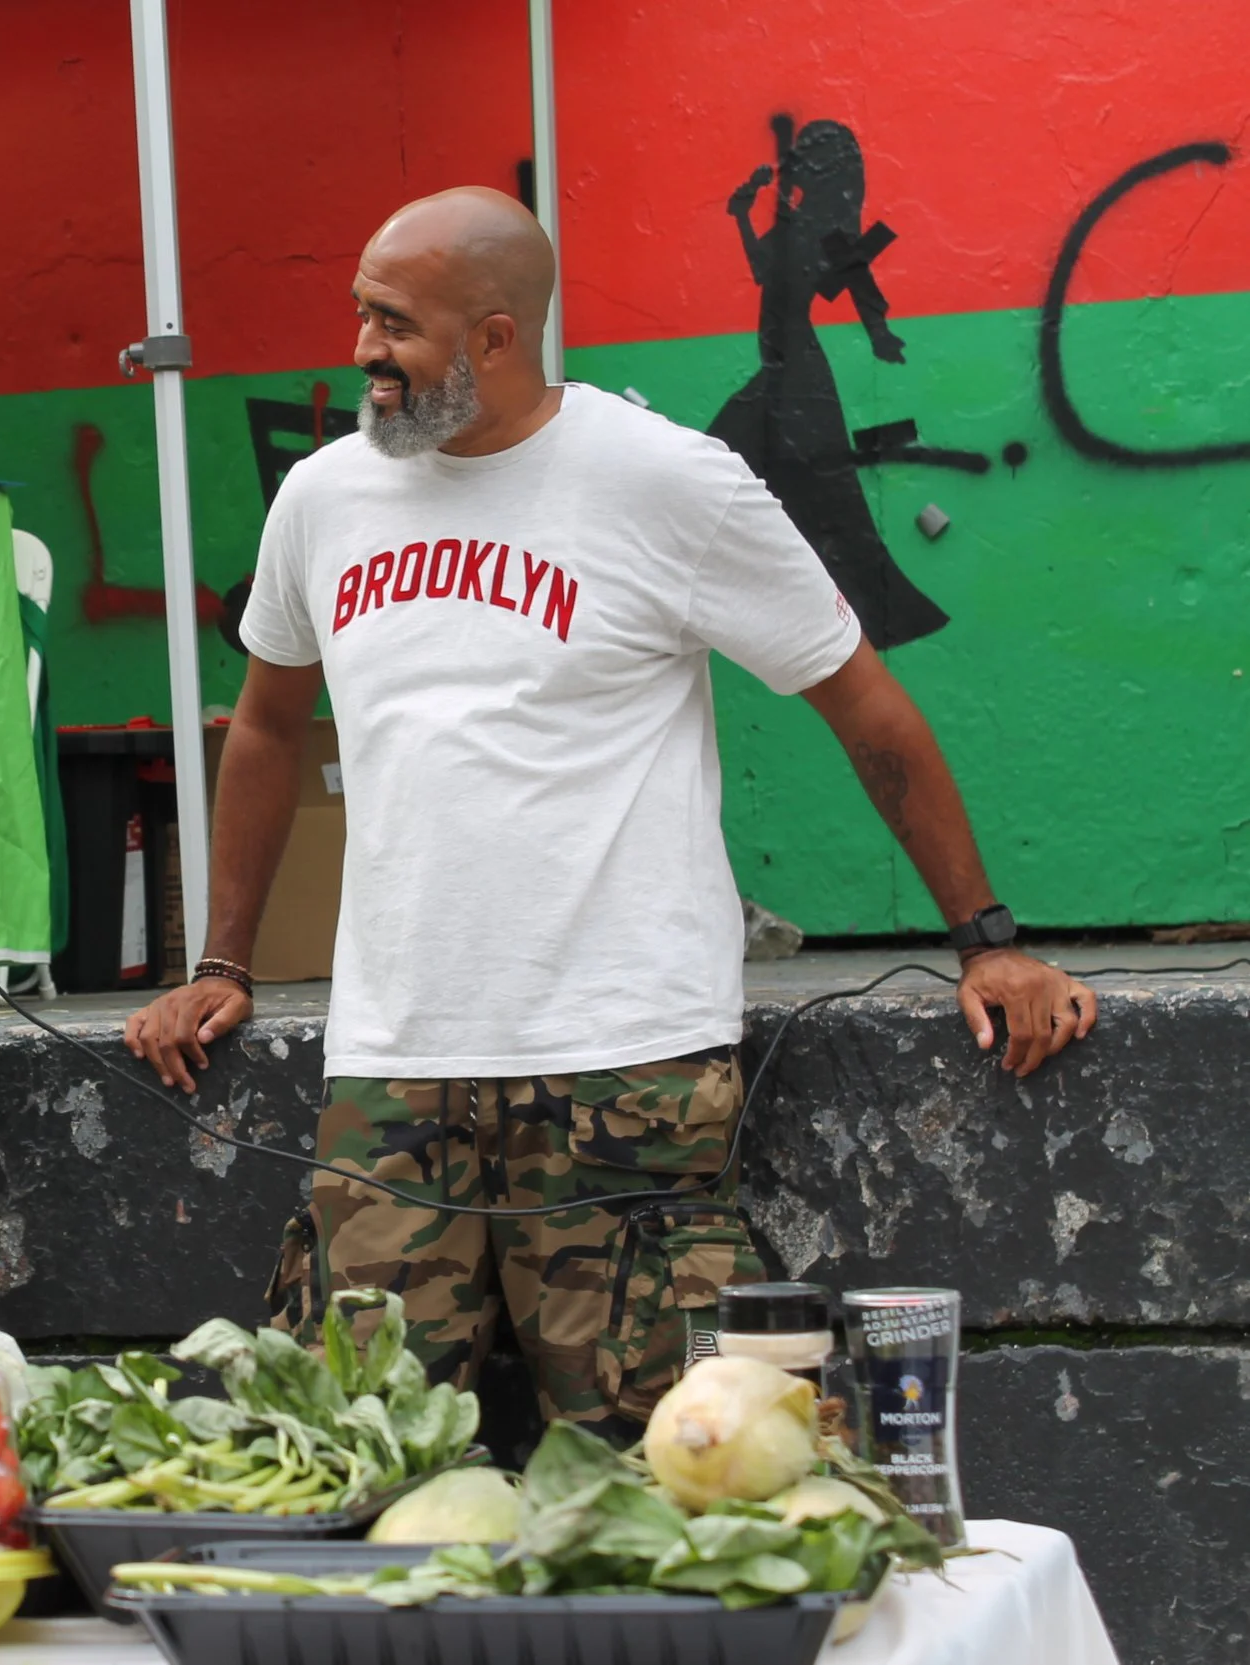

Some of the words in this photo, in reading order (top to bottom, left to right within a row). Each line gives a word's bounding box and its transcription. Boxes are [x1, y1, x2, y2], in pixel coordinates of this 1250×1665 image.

[333, 539, 578, 643] BROOKLYN
[863, 1308, 950, 1332] ADJUSTABLE
[866, 1320, 951, 1347] GRINDER
[880, 1412, 942, 1425] MORTON
[891, 1453, 934, 1464] BLACK
